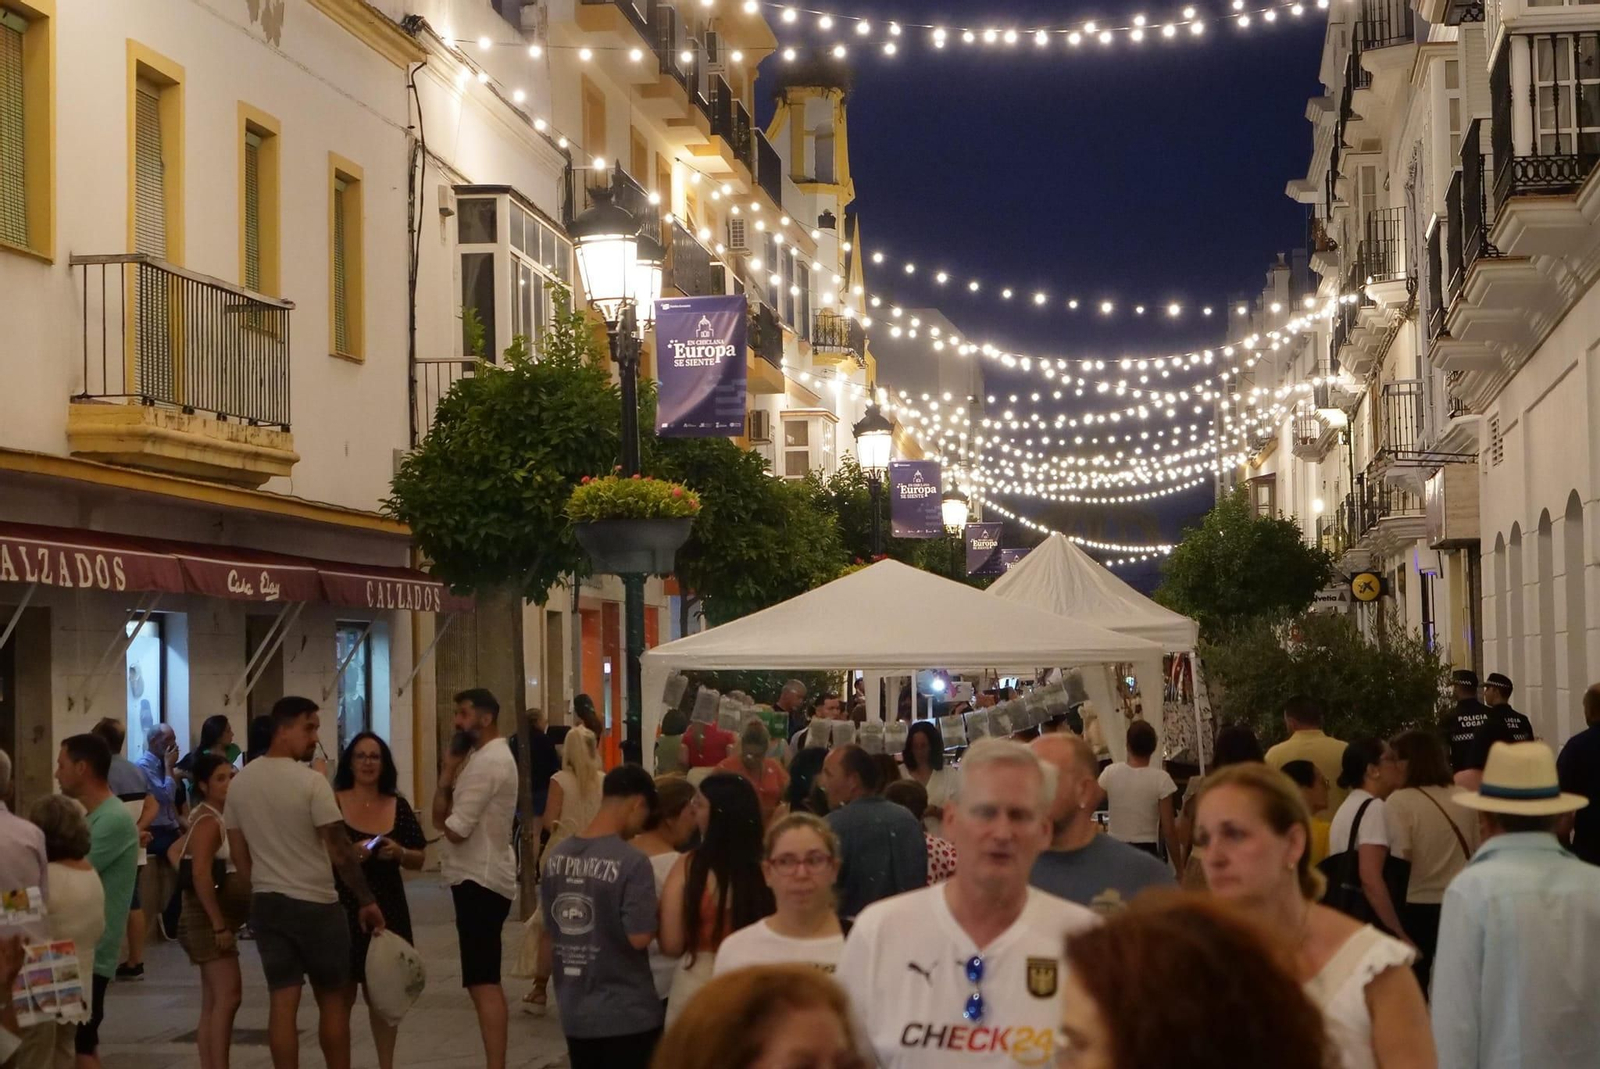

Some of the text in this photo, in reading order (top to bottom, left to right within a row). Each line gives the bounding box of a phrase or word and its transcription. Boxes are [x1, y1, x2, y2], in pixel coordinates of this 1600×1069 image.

[674, 343, 737, 363] Europa
[674, 358, 715, 367] SE SIENTE
[901, 485, 937, 497] Europa
[973, 540, 998, 549] Europa
[0, 544, 126, 591] ALZADOS
[227, 569, 280, 601] Casa Eloy
[366, 581, 441, 612] CALZADOS
[1458, 714, 1488, 722] POLICIA
[900, 1022, 1055, 1054] CHECK24
